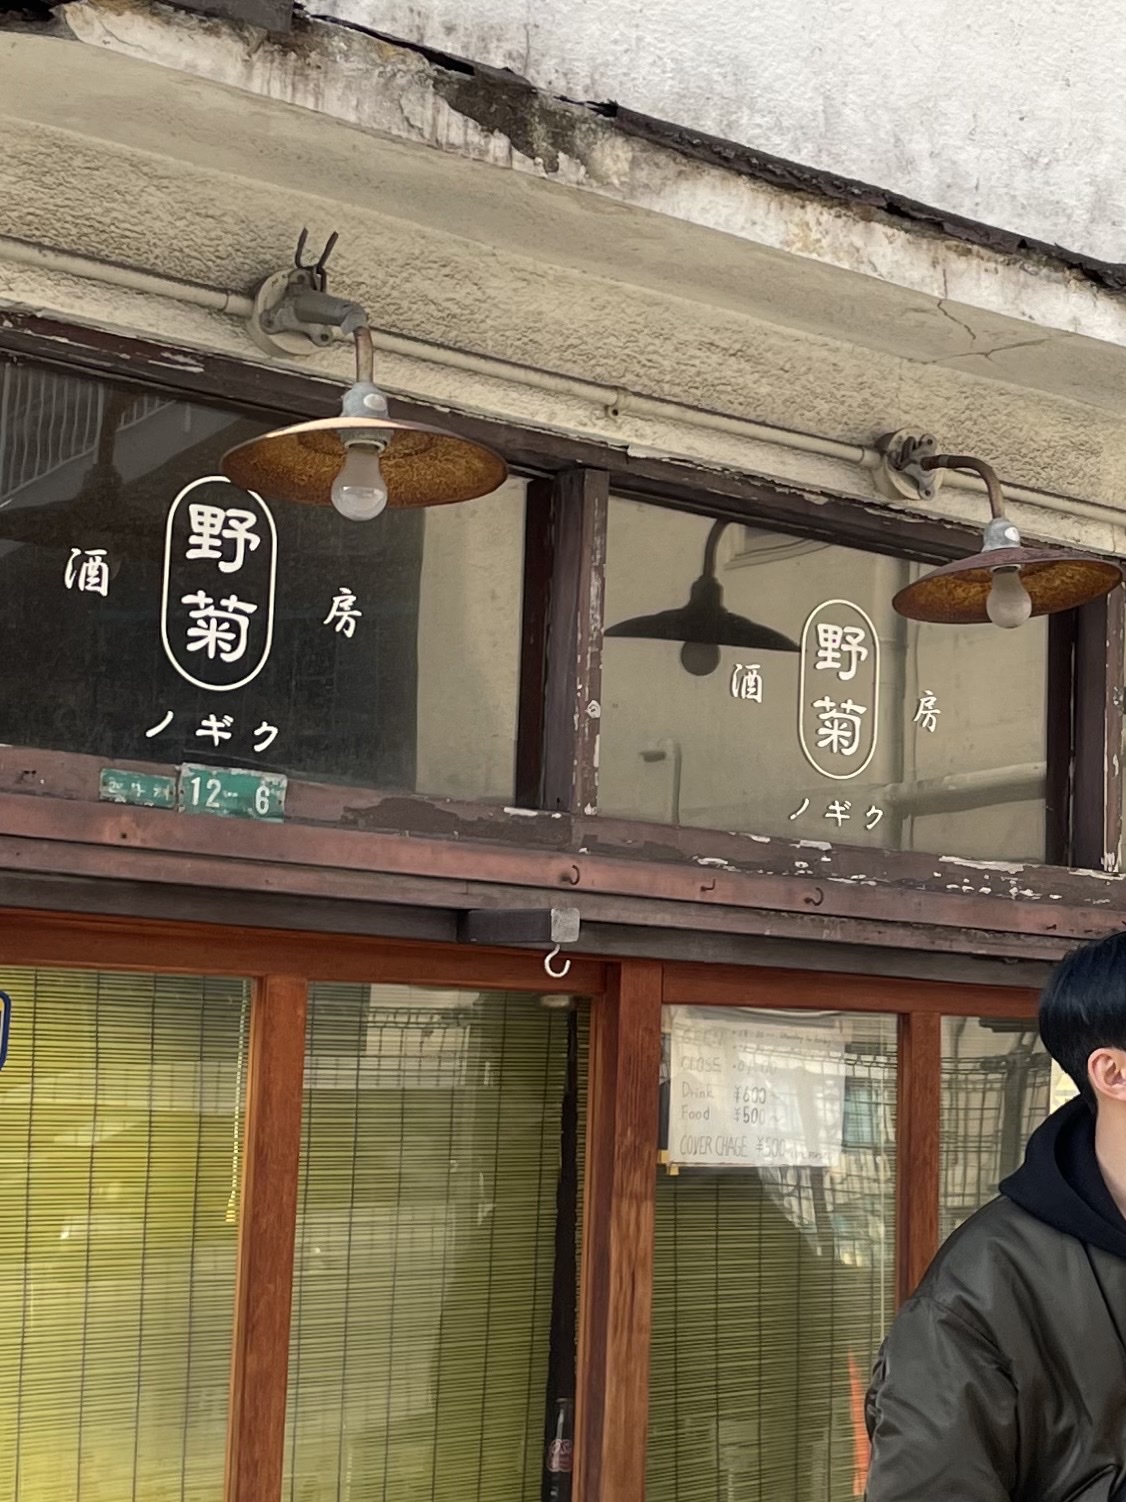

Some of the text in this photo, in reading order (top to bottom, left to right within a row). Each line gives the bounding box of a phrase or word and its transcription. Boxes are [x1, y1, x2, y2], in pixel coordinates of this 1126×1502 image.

[64, 547, 363, 638] 酒 房
[181, 502, 261, 663] 野菊
[730, 663, 941, 732] 酒 房
[811, 623, 868, 757] 野菊
[145, 710, 279, 753] ノギク
[789, 797, 884, 830] ノギク
[681, 1080, 715, 1100] Drink
[681, 1104, 711, 1121] Food
[679, 1134, 713, 1157] COVER
